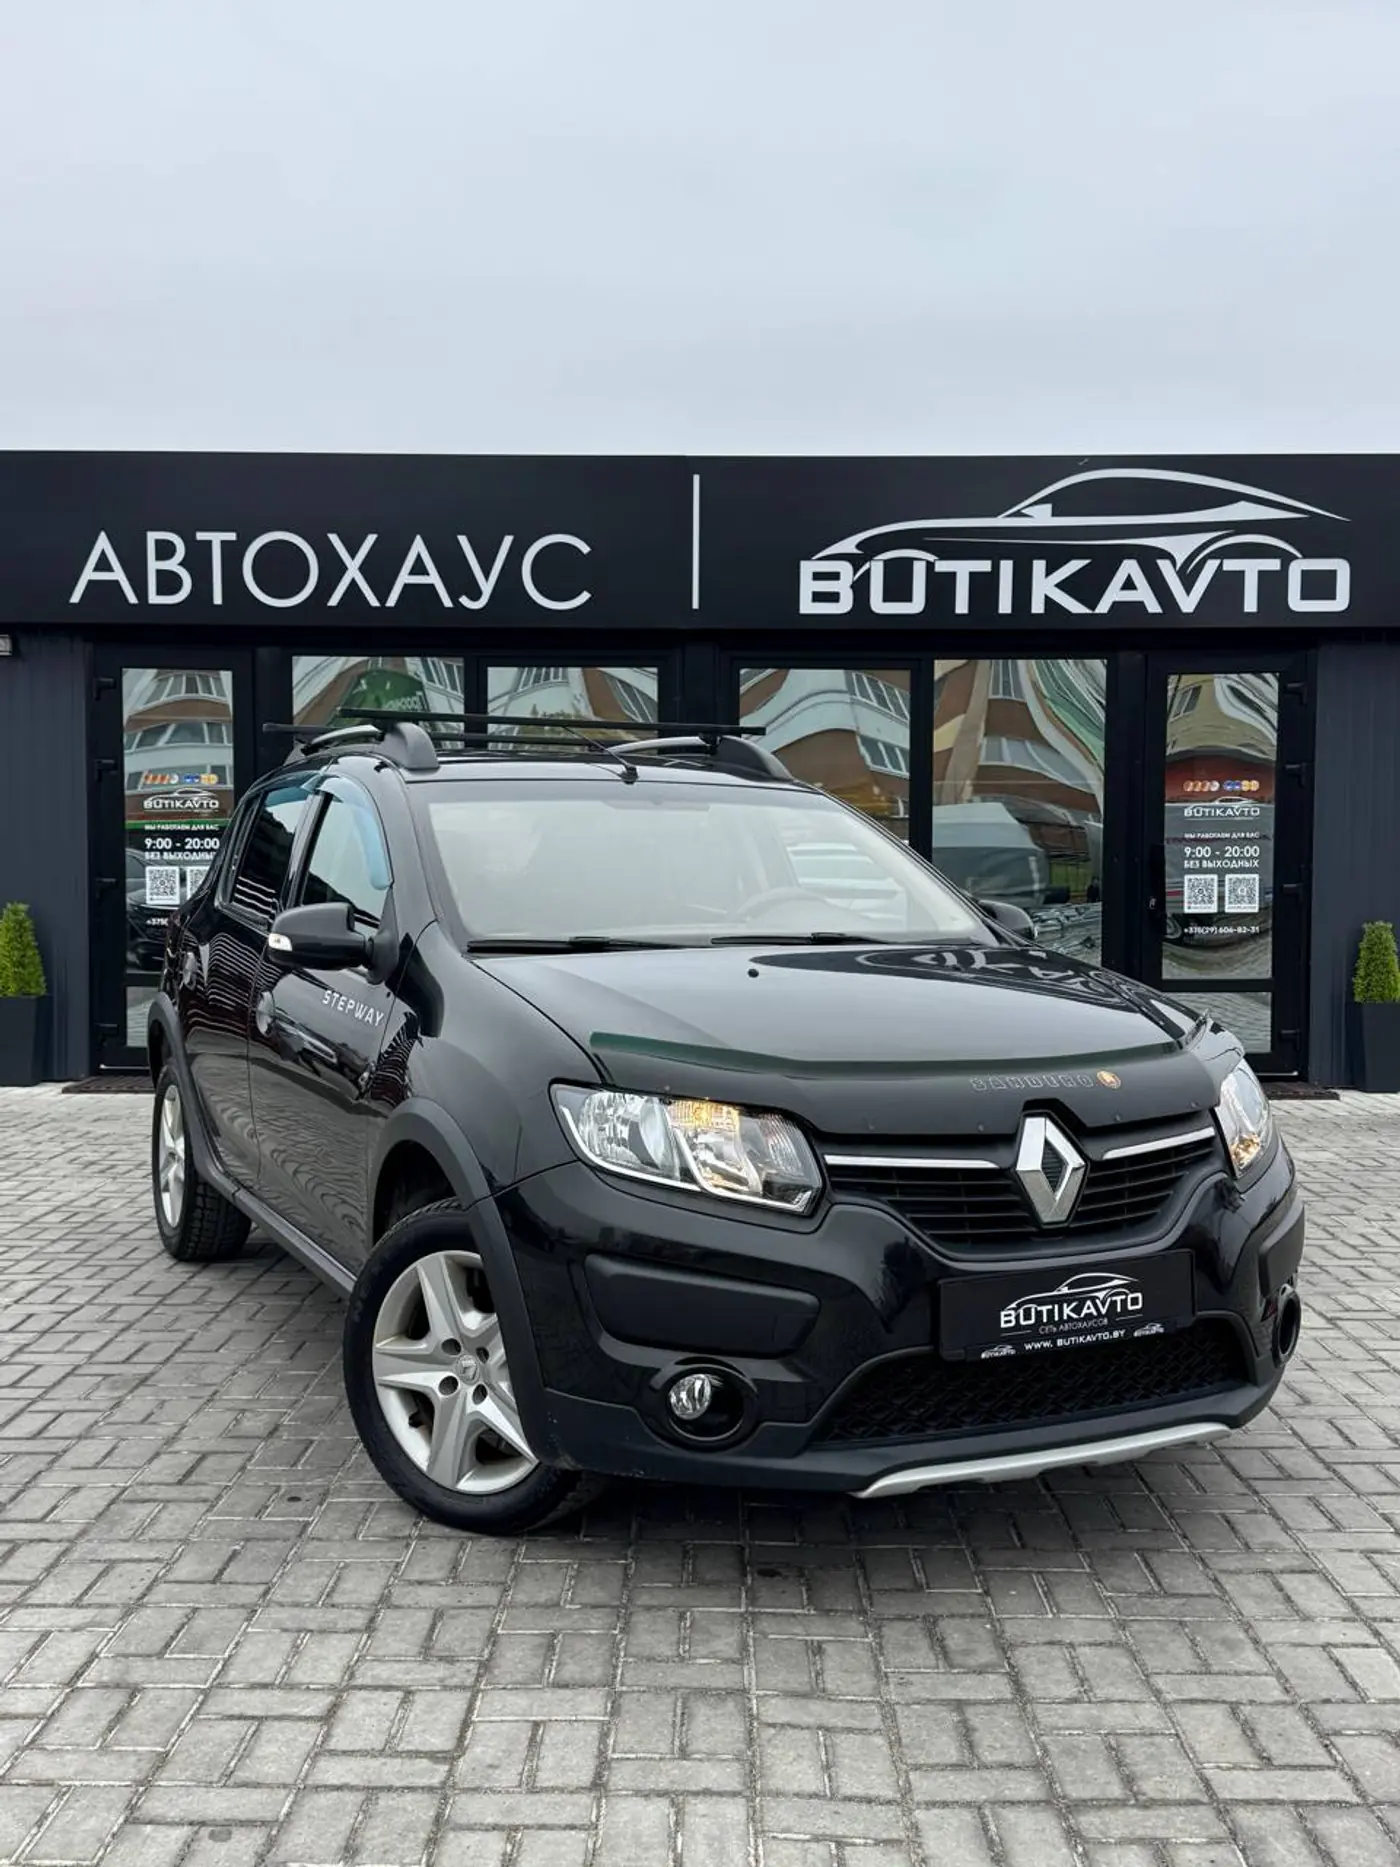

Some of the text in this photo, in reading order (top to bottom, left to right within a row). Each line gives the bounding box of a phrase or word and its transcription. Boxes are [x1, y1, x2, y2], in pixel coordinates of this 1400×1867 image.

[69, 530, 592, 611] АВТОХАУС
[798, 556, 1352, 615] BUTIKAVTO
[143, 799, 220, 809] BUTIKAVTO
[1183, 806, 1260, 817] BUTIKAVTO
[144, 838, 172, 849] 9:00
[184, 838, 220, 849] 20:00
[163, 851, 216, 860] ВЫХОДНЫ
[1184, 846, 1212, 858] 9:00
[1224, 845, 1260, 858] 20:00
[1184, 860, 1260, 868] БЕЗ ВЫХОДНЫХ
[322, 990, 384, 1026] STEPWAY
[1000, 1292, 1143, 1328] BUTIKAVTO
[1057, 1329, 1126, 1347] BUTIKAVTO.BY
